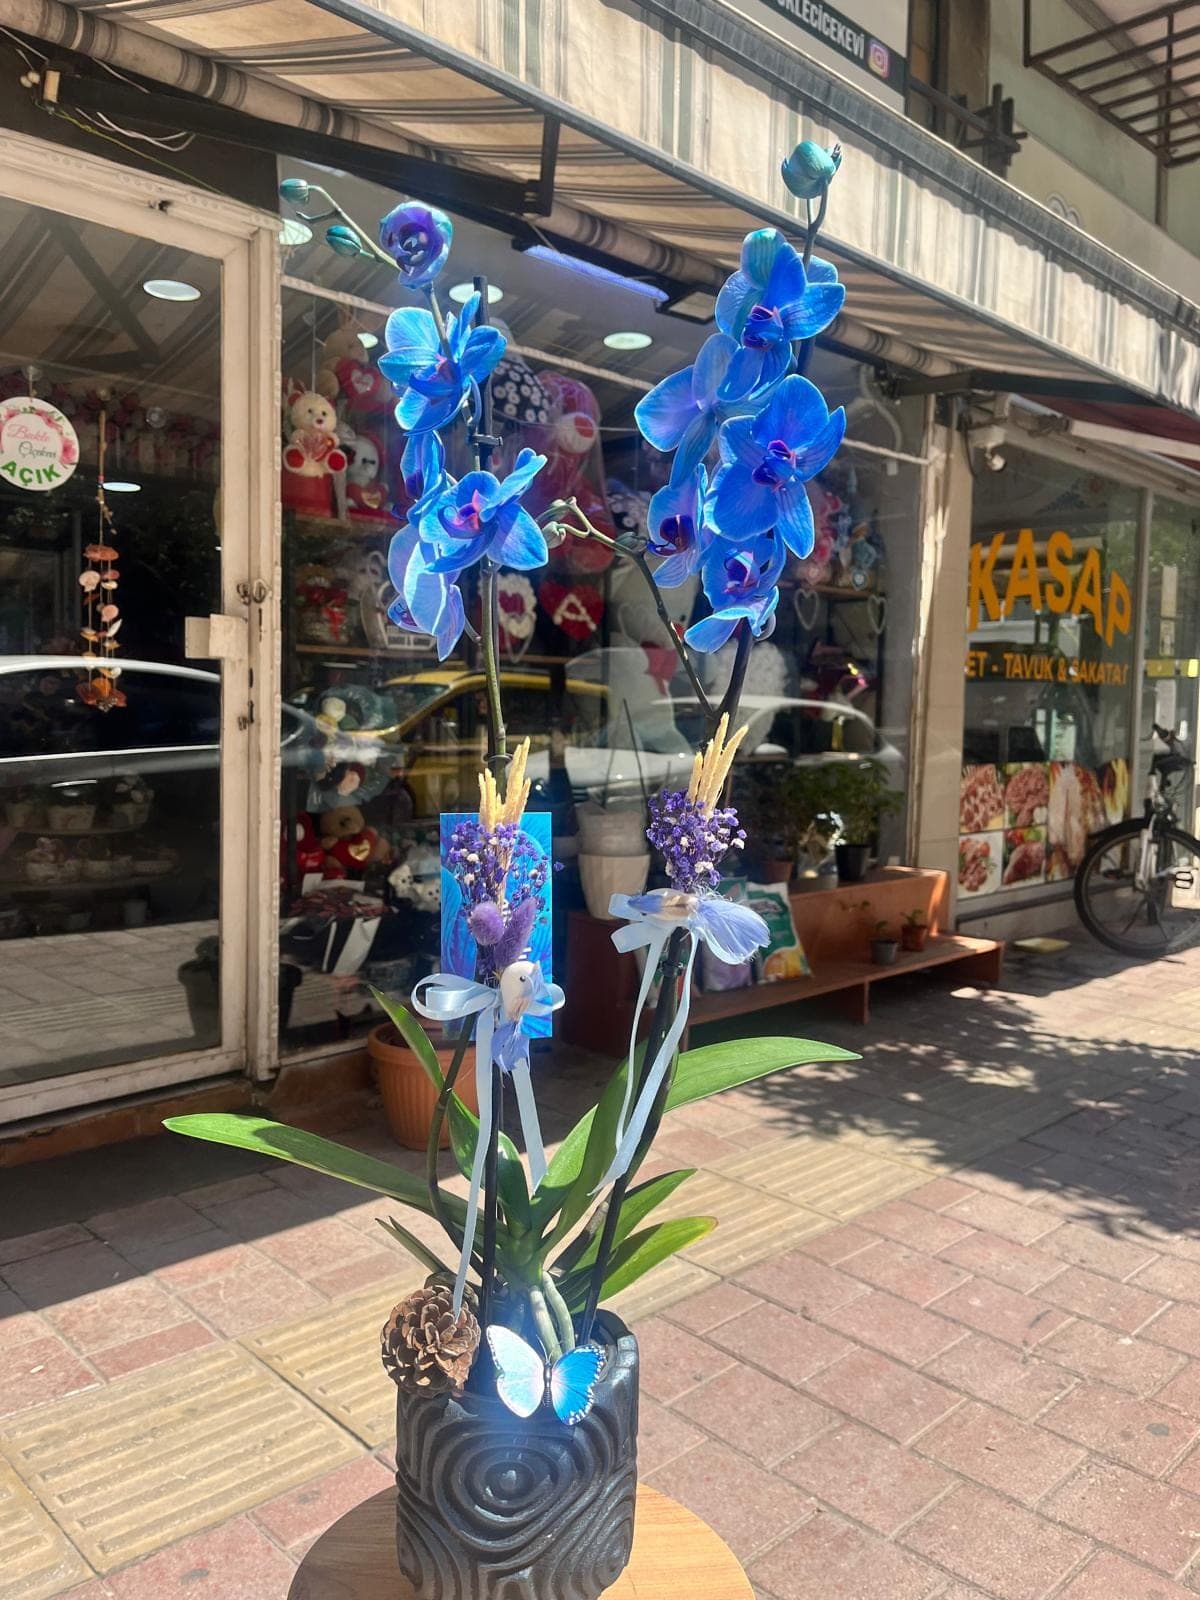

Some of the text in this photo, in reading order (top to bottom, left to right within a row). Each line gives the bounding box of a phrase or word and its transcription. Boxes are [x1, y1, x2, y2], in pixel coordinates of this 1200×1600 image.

[1, 461, 61, 486] AÇIK
[967, 528, 1132, 649] KASAP
[1003, 652, 1054, 681] TAVUK
[1058, 656, 1066, 682] &
